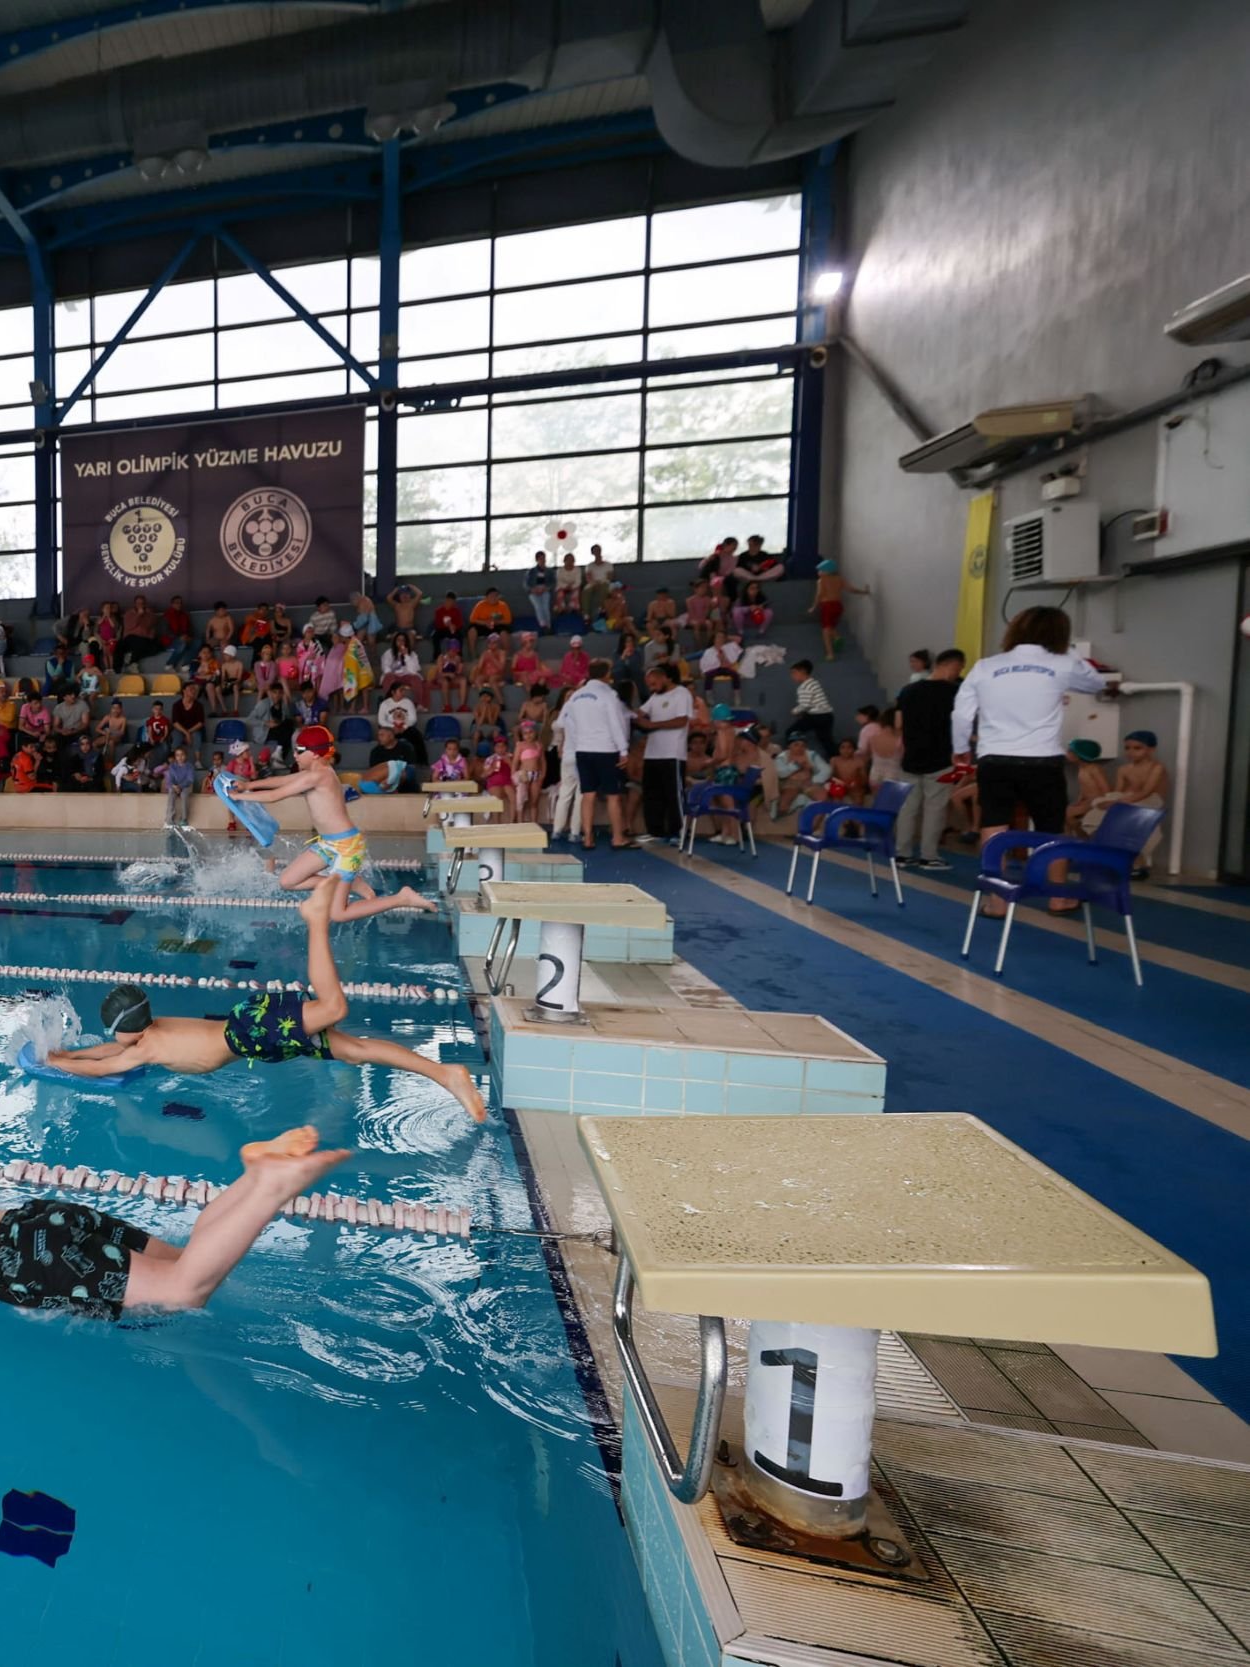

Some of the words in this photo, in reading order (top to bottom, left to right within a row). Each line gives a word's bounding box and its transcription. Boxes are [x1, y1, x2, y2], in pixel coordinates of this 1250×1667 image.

[74, 461, 111, 478] YARI
[116, 451, 189, 475] OLİMPİK
[194, 448, 258, 468] YÜZME
[264, 439, 343, 463] HAVUZU
[104, 502, 127, 523] BUCA
[241, 494, 287, 512] BUCA
[228, 538, 303, 572] BELEDİYESİ
[124, 576, 137, 587] VE
[138, 573, 165, 587] SPOR
[133, 565, 152, 573] 1990
[536, 953, 565, 1010] 2
[754, 1348, 843, 1497] 1
